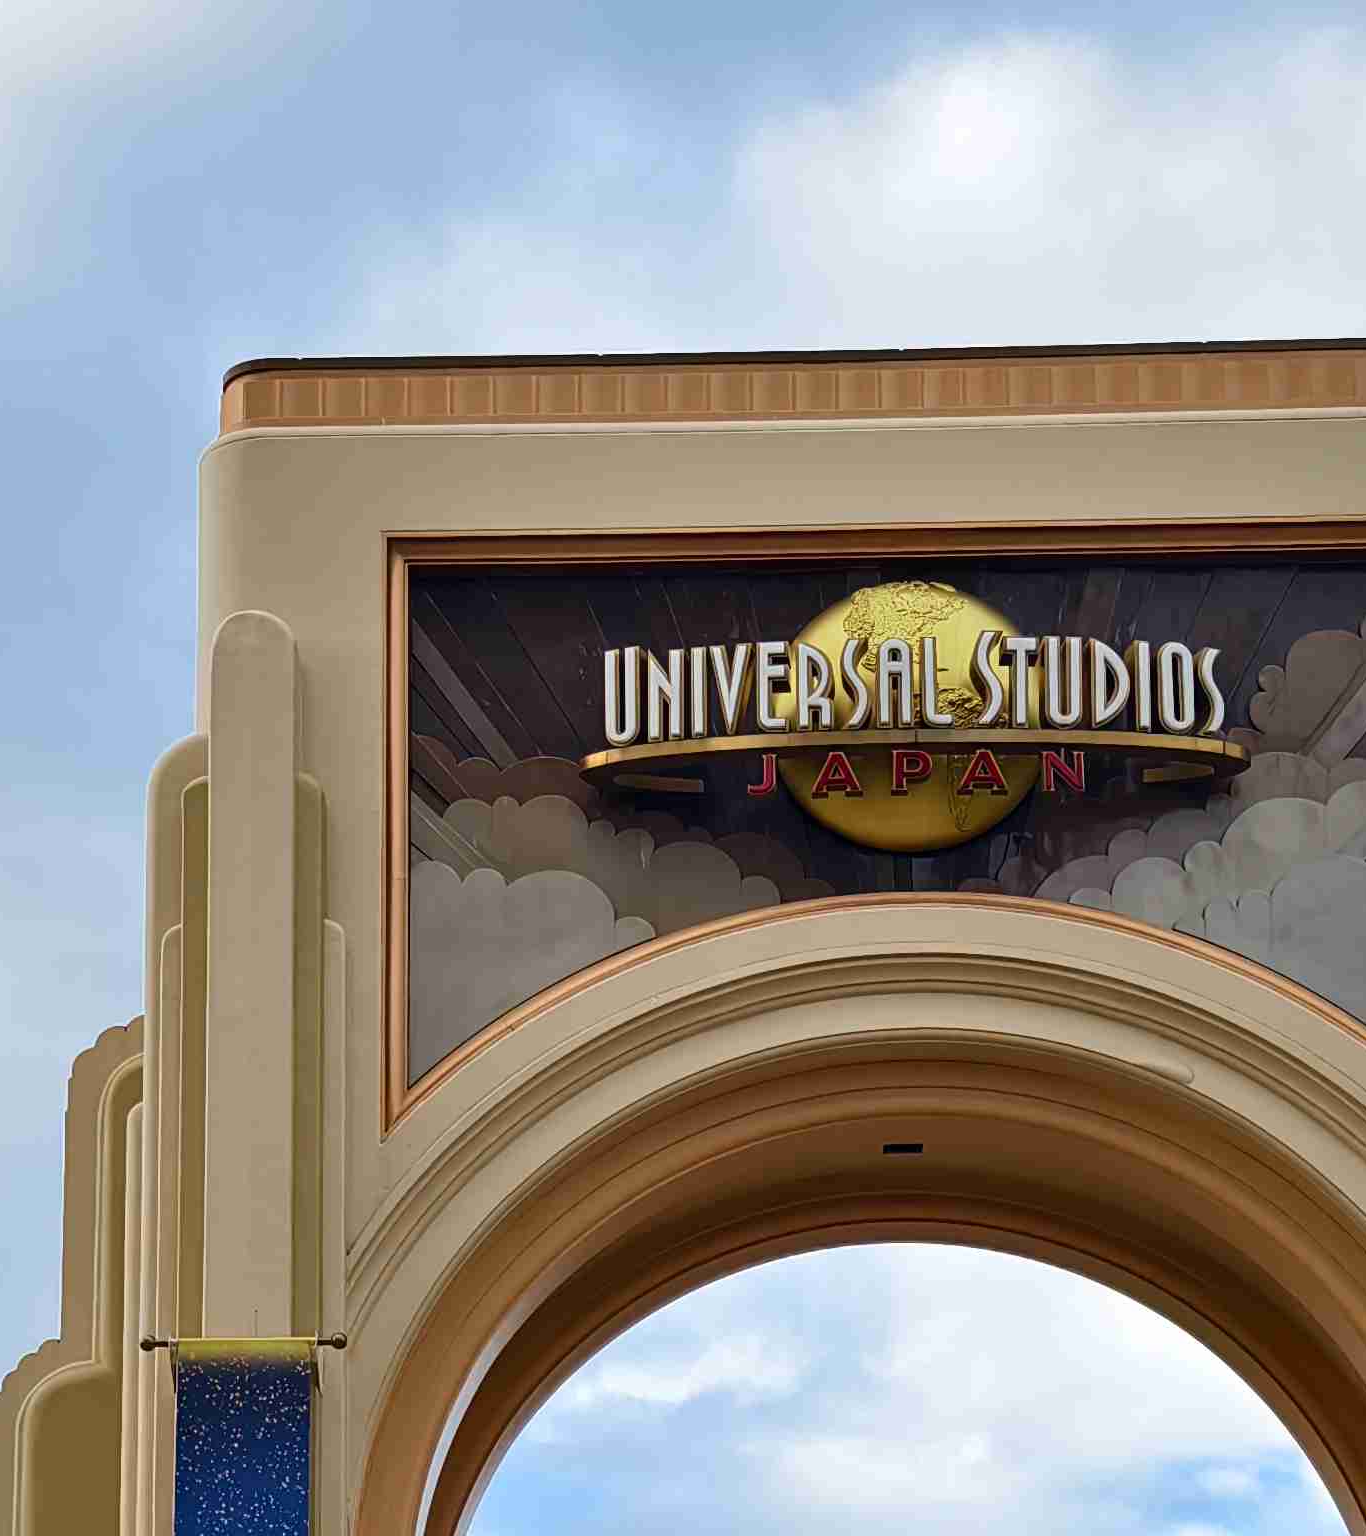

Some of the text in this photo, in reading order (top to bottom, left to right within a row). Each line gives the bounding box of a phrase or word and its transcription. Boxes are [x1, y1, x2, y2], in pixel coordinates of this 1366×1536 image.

[603, 630, 1227, 747] UNIVERSAL STUDIOS
[746, 748, 1085, 798] JAPAN
